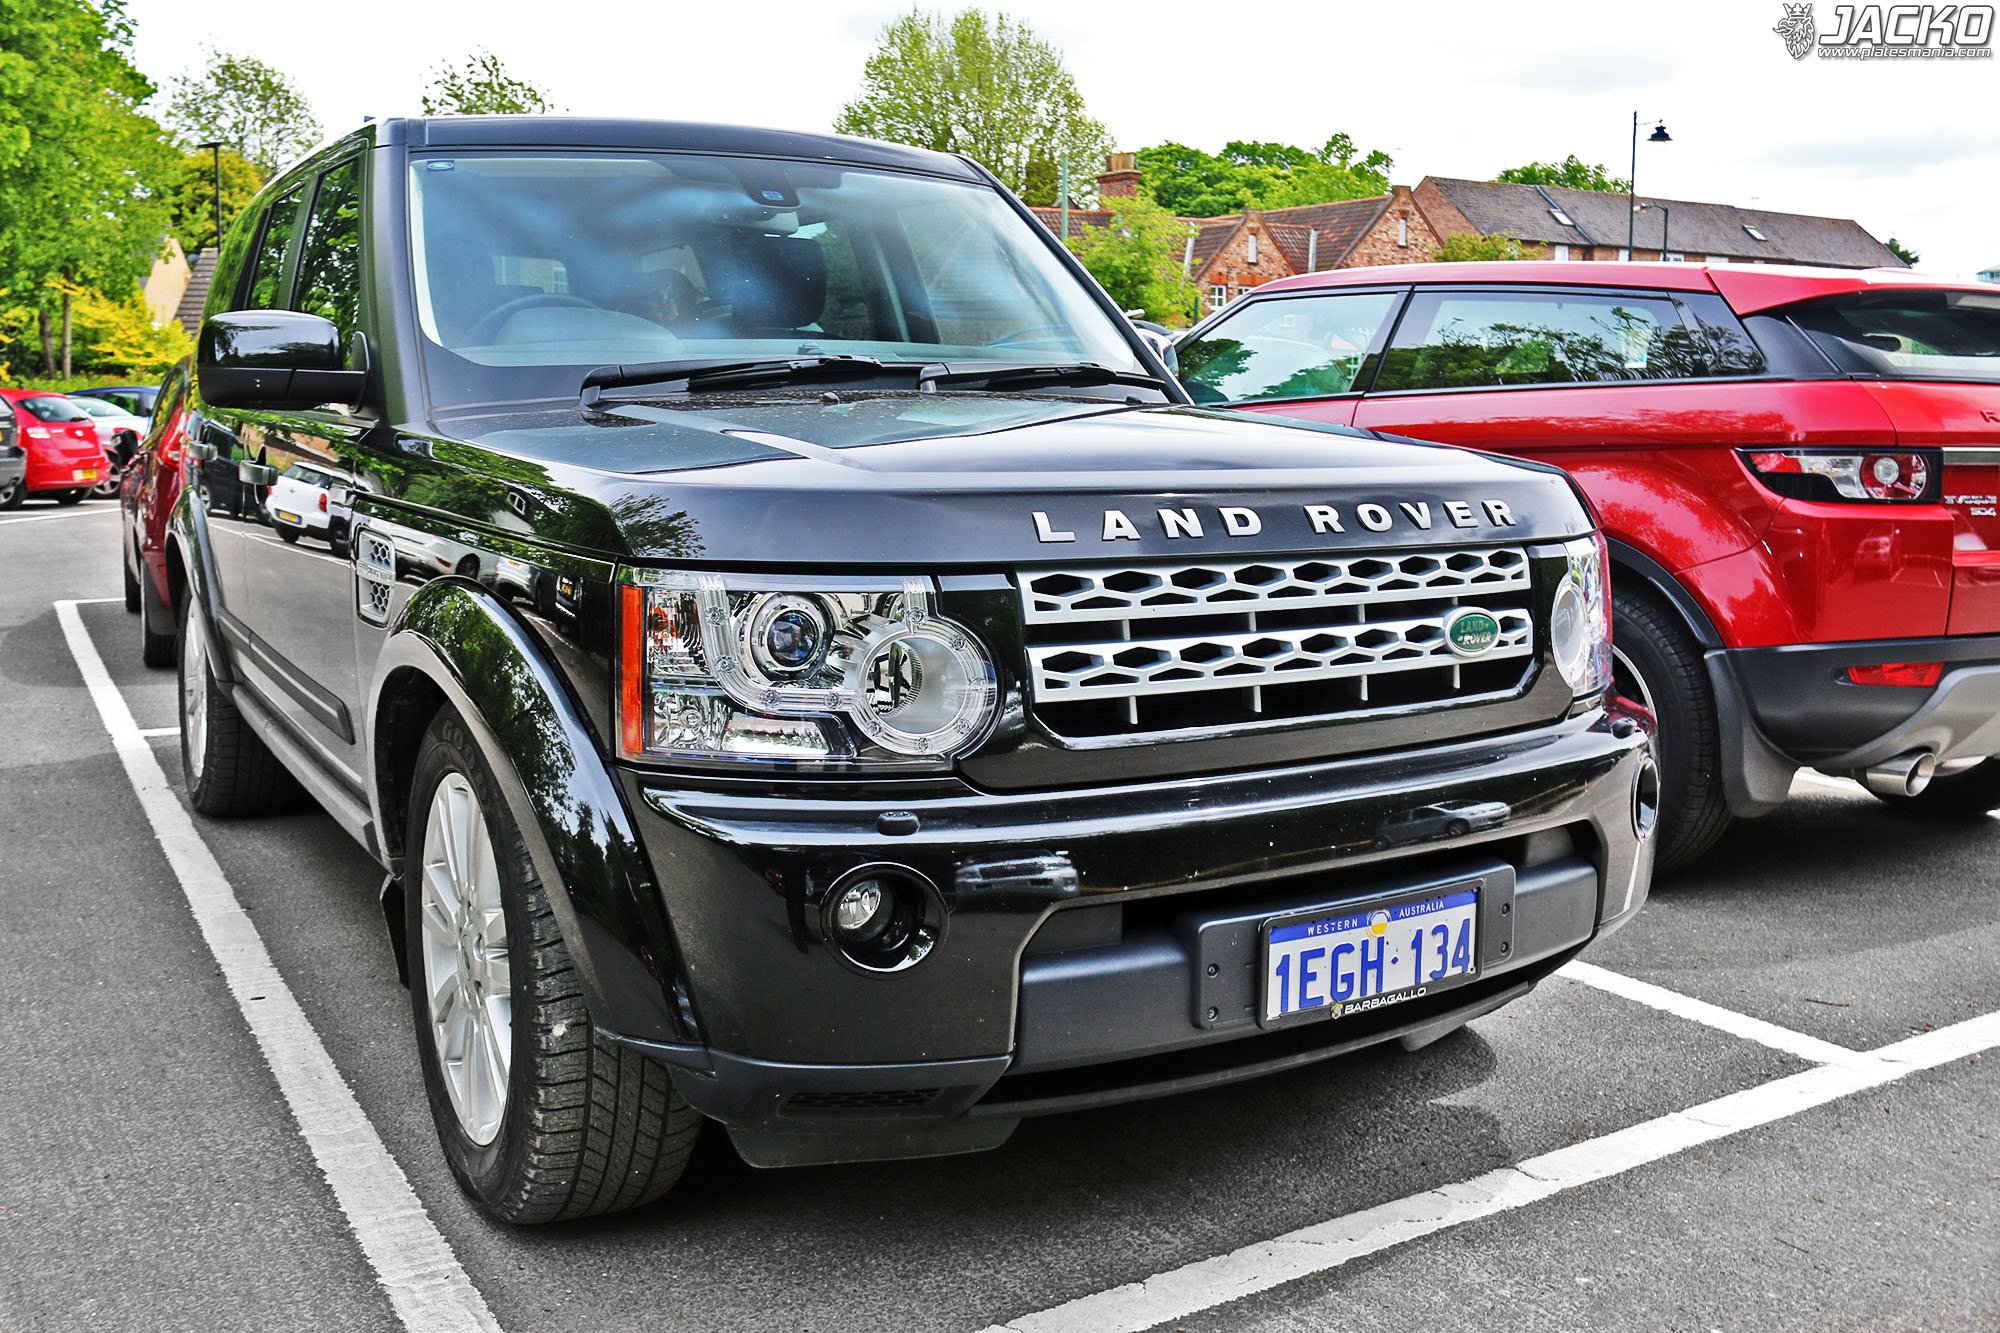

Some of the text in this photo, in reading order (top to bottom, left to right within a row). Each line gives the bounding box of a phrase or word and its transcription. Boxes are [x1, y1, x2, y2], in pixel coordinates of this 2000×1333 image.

[1032, 499, 1518, 543] LAND ROVER
[1460, 620, 1484, 633] LAND
[1463, 631, 1492, 645] ROVER
[1307, 900, 1445, 936] WESTERN AUSTRALIA
[1344, 986, 1427, 1014] BARBAGALLO
